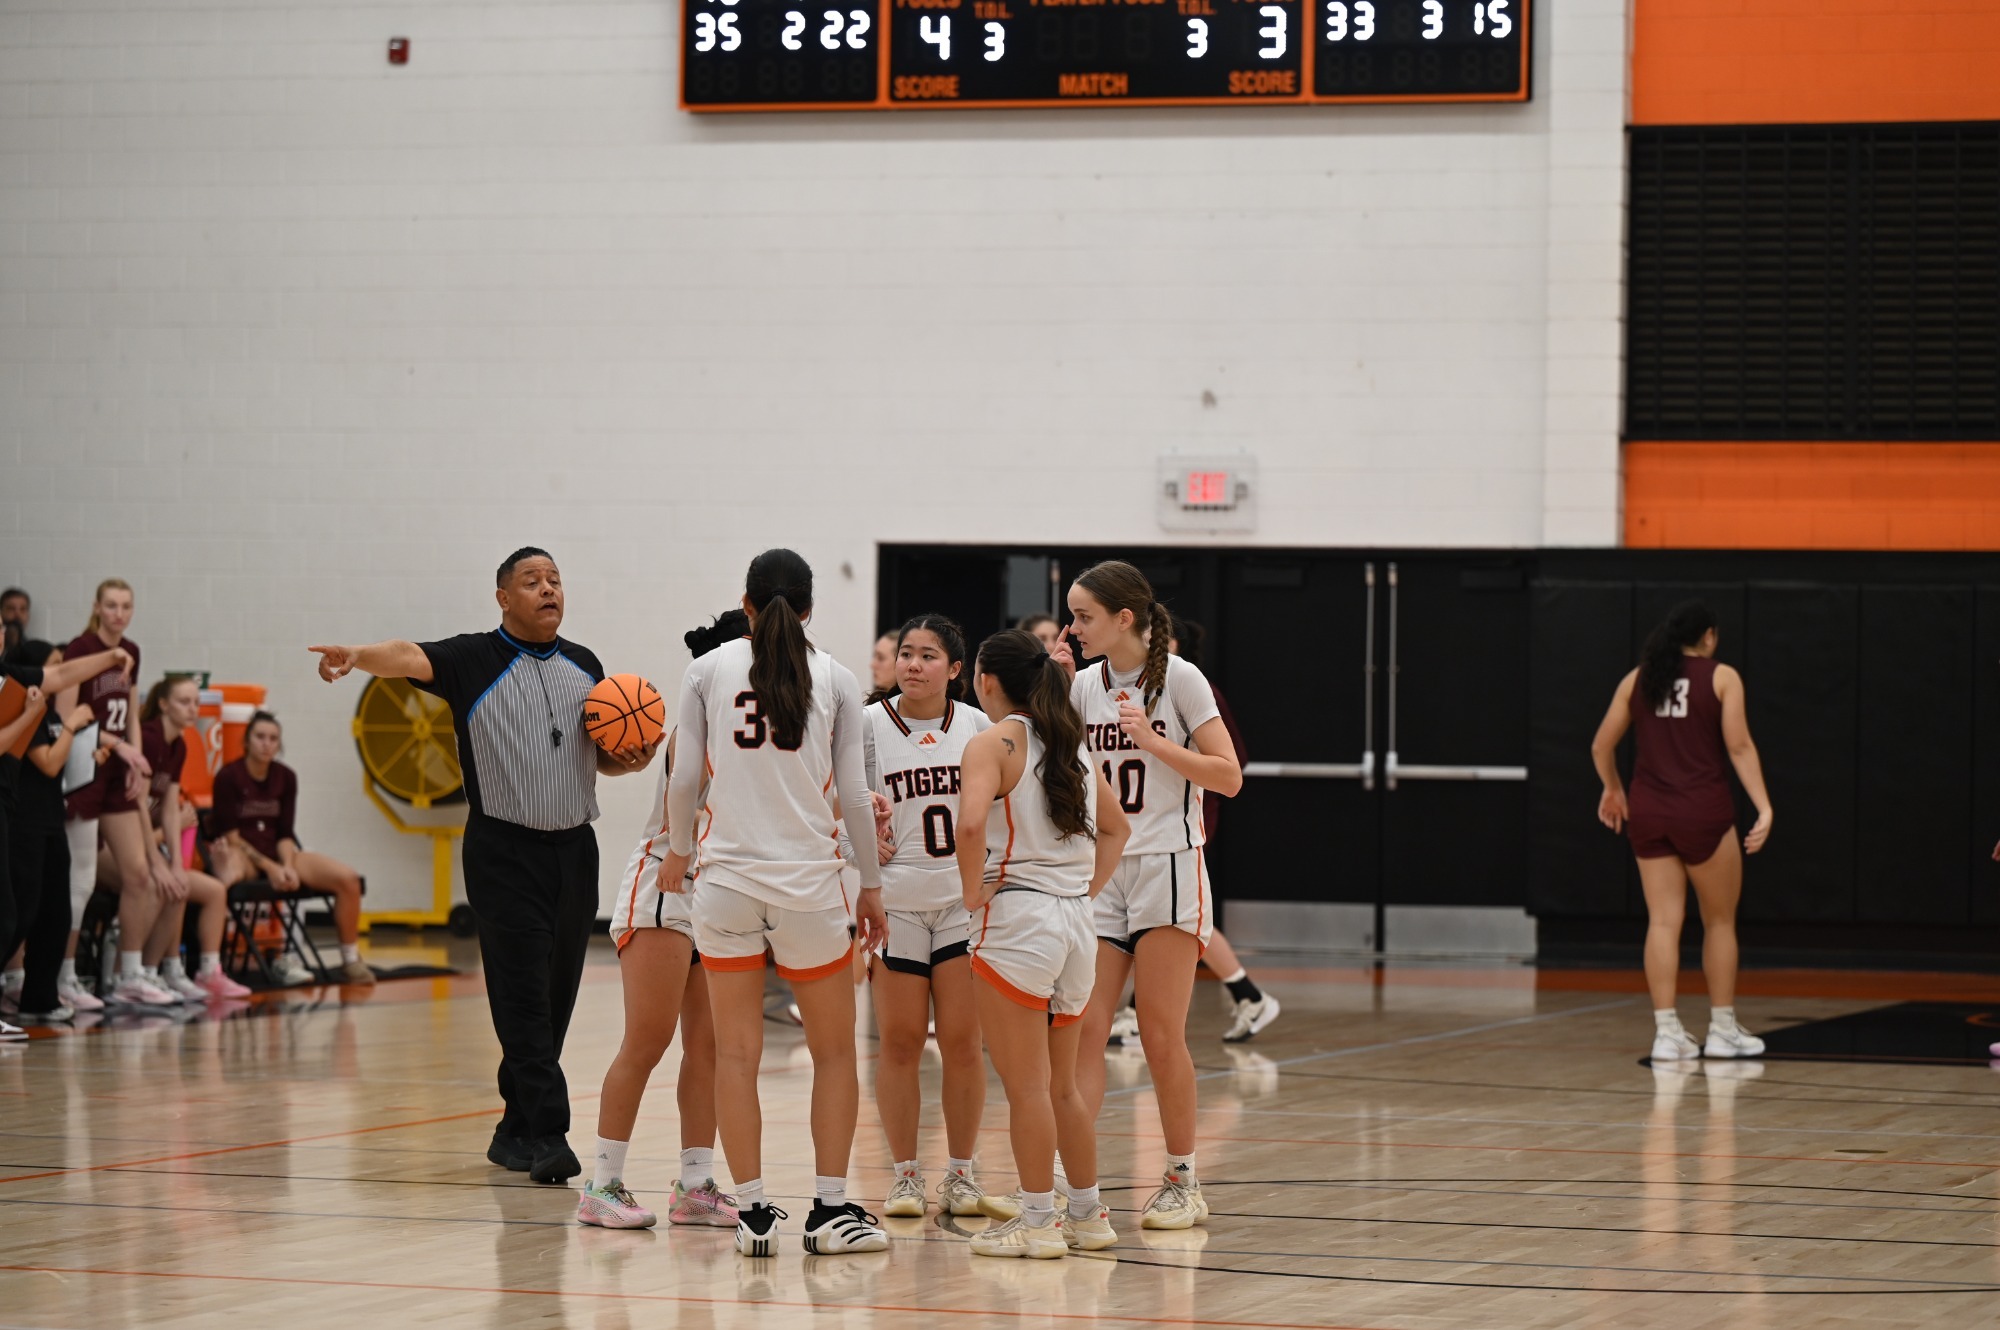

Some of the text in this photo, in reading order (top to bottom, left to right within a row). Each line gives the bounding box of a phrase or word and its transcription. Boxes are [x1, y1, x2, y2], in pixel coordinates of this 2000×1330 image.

[695, 10, 871, 52] 35 2 22
[919, 15, 951, 61] 4
[1186, 19, 1209, 58] 3
[1258, 5, 1287, 60] 3
[1326, 0, 1512, 41] 33 3 15
[983, 22, 1006, 62] 3
[894, 75, 959, 99] SCORE
[1059, 72, 1129, 96] MATCH
[1228, 69, 1297, 95] SCORE
[105, 698, 128, 731] 22
[1086, 720, 1167, 753] TIGES
[922, 803, 956, 859] 0
